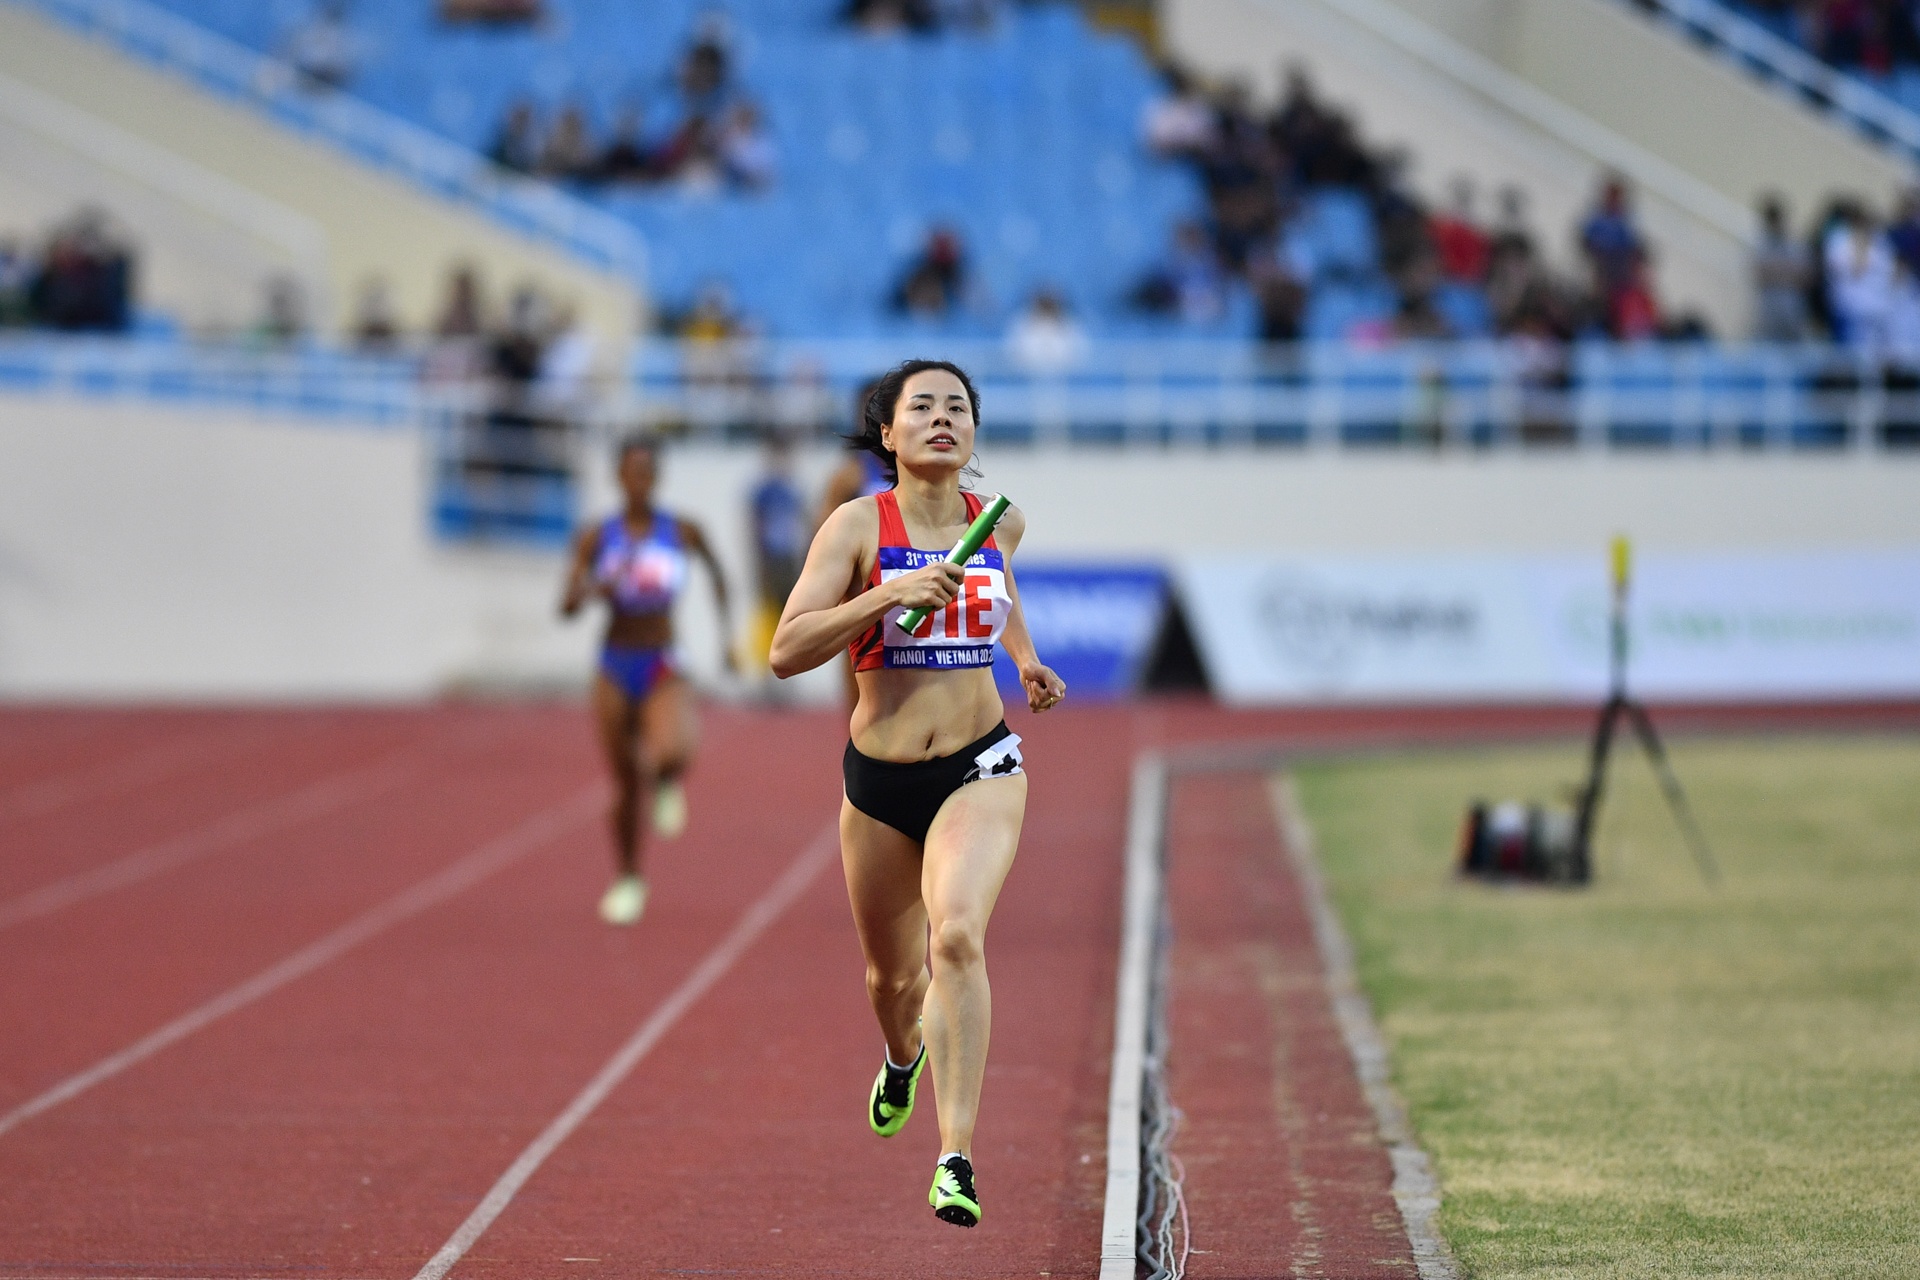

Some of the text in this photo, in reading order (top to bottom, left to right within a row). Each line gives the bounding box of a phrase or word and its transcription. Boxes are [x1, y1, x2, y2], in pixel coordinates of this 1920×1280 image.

[893, 650, 926, 665] HANOI
[935, 649, 980, 665] VIETNAM
[980, 648, 994, 663] 202
